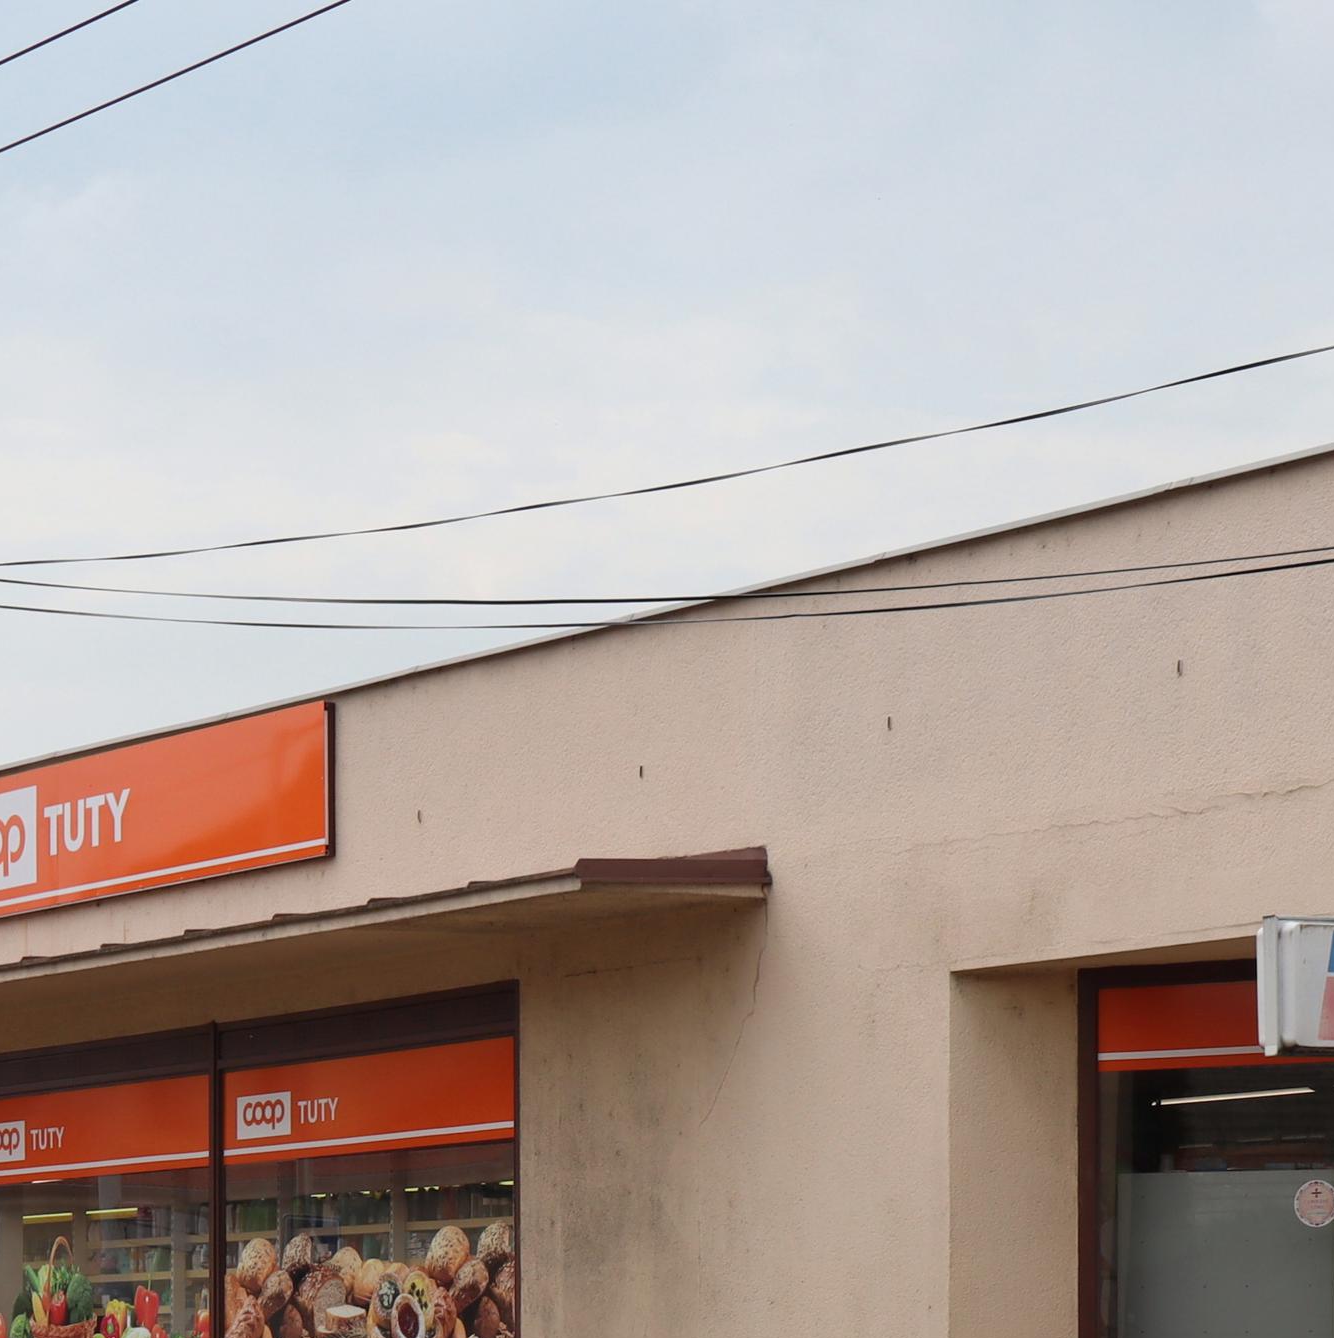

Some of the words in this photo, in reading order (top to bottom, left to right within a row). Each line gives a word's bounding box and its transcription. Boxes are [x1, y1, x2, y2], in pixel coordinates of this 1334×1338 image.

[44, 788, 131, 856] TUTY
[243, 1098, 285, 1130] coop
[297, 1097, 339, 1125] TUTY
[30, 1126, 65, 1151] TUTY
